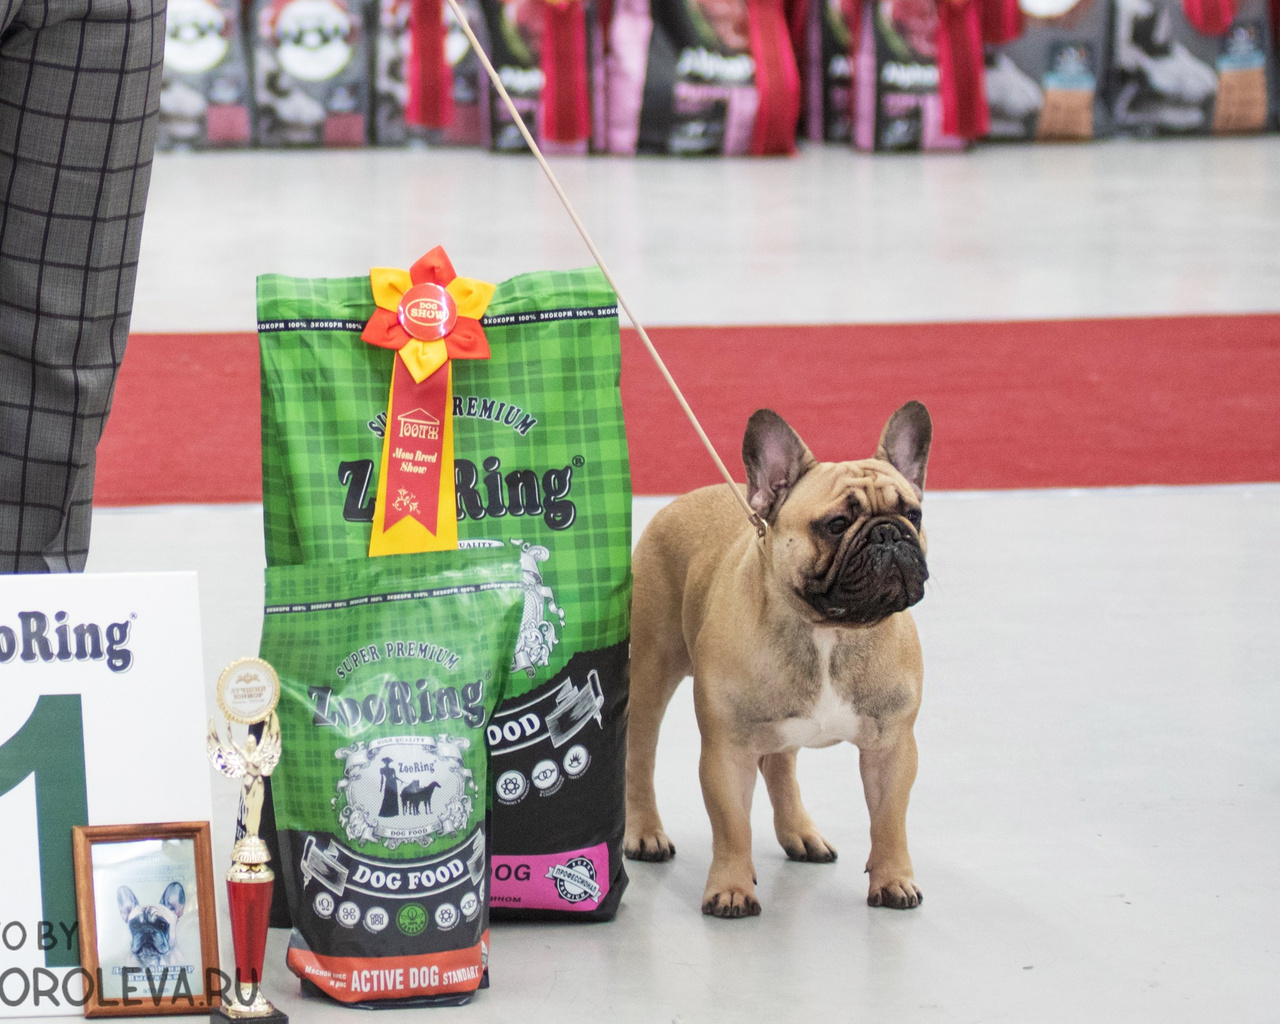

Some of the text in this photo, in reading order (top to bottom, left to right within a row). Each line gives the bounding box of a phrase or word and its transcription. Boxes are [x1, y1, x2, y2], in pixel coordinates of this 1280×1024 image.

[410, 308, 446, 320] SHOW
[419, 302, 438, 310] DOG
[257, 321, 285, 330] КОКОРМ
[310, 321, 343, 329] ЭКОКОРМ
[483, 316, 515, 325] ЭКОКОРМ
[518, 314, 537, 322] 100%
[540, 310, 573, 320] ЭКОКОРМ
[576, 309, 594, 317] 100%
[452, 396, 538, 436] REMIUM
[392, 447, 438, 464] Mono Breed
[400, 461, 428, 475] Show
[336, 641, 461, 680] SUPER PREMIUM
[487, 713, 540, 745] OOD
[377, 737, 392, 745] HIGH
[352, 859, 464, 890] DOG FOOD
[490, 864, 531, 882] OG
[351, 965, 481, 993] ACTIVE DOG STANDART
